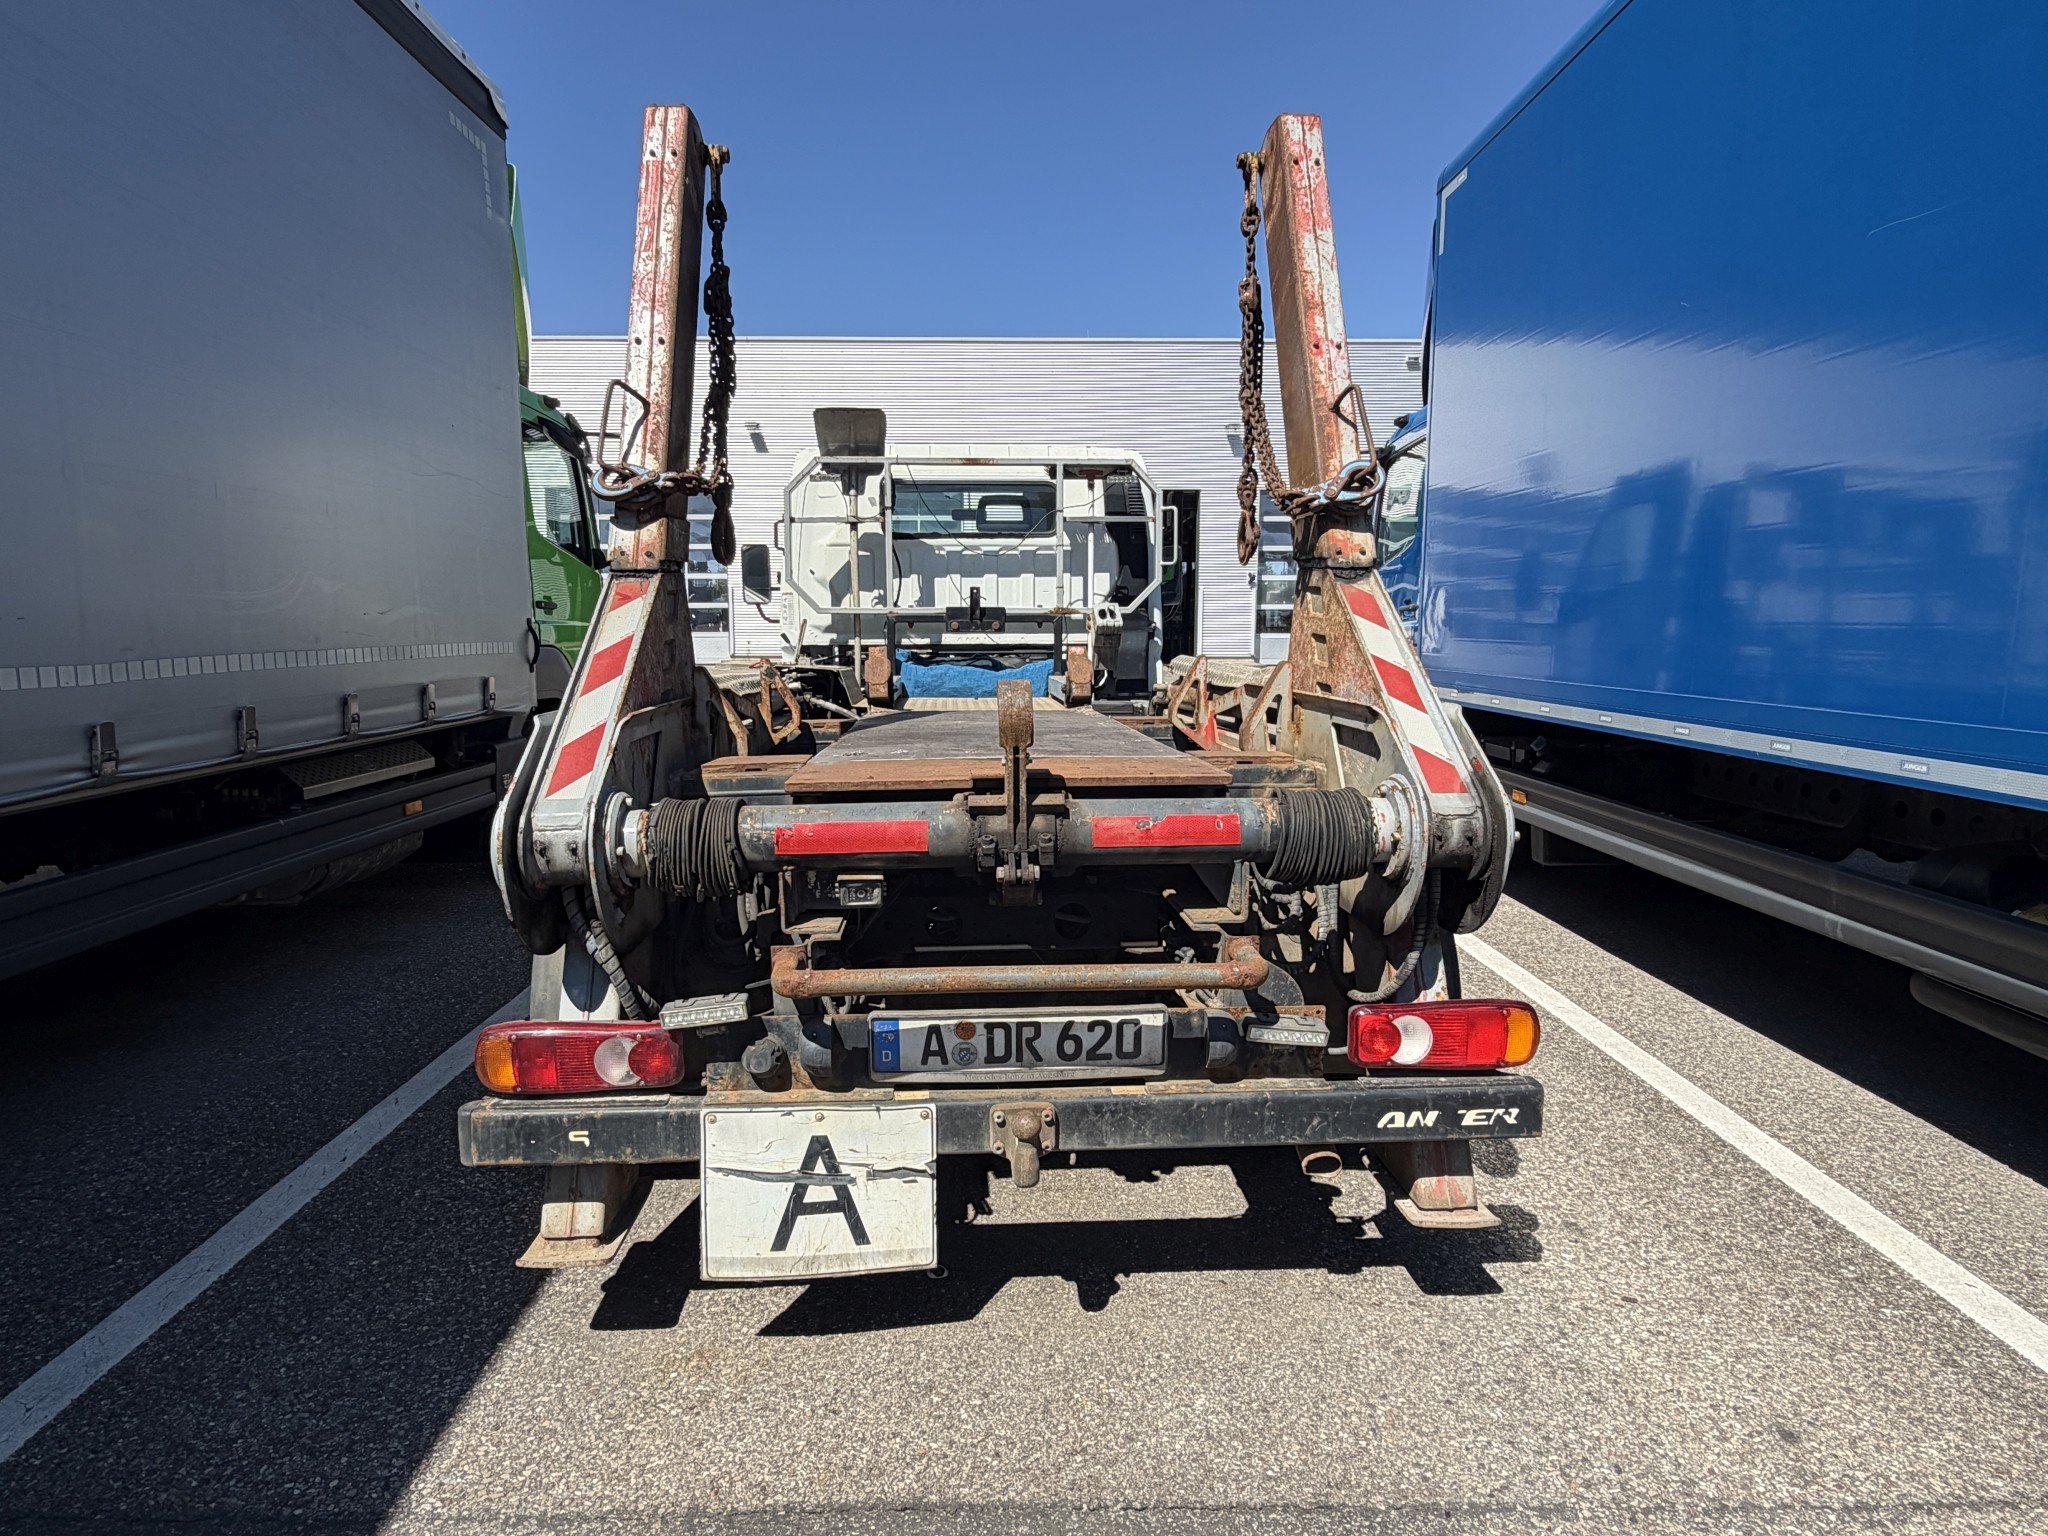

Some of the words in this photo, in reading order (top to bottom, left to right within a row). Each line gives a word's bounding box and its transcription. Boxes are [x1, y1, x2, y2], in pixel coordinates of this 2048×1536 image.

[882, 1050, 892, 1062] D
[920, 1023, 949, 1066] A
[983, 1021, 1044, 1065] DR
[1056, 1018, 1143, 1062] 620
[770, 1134, 872, 1252] A
